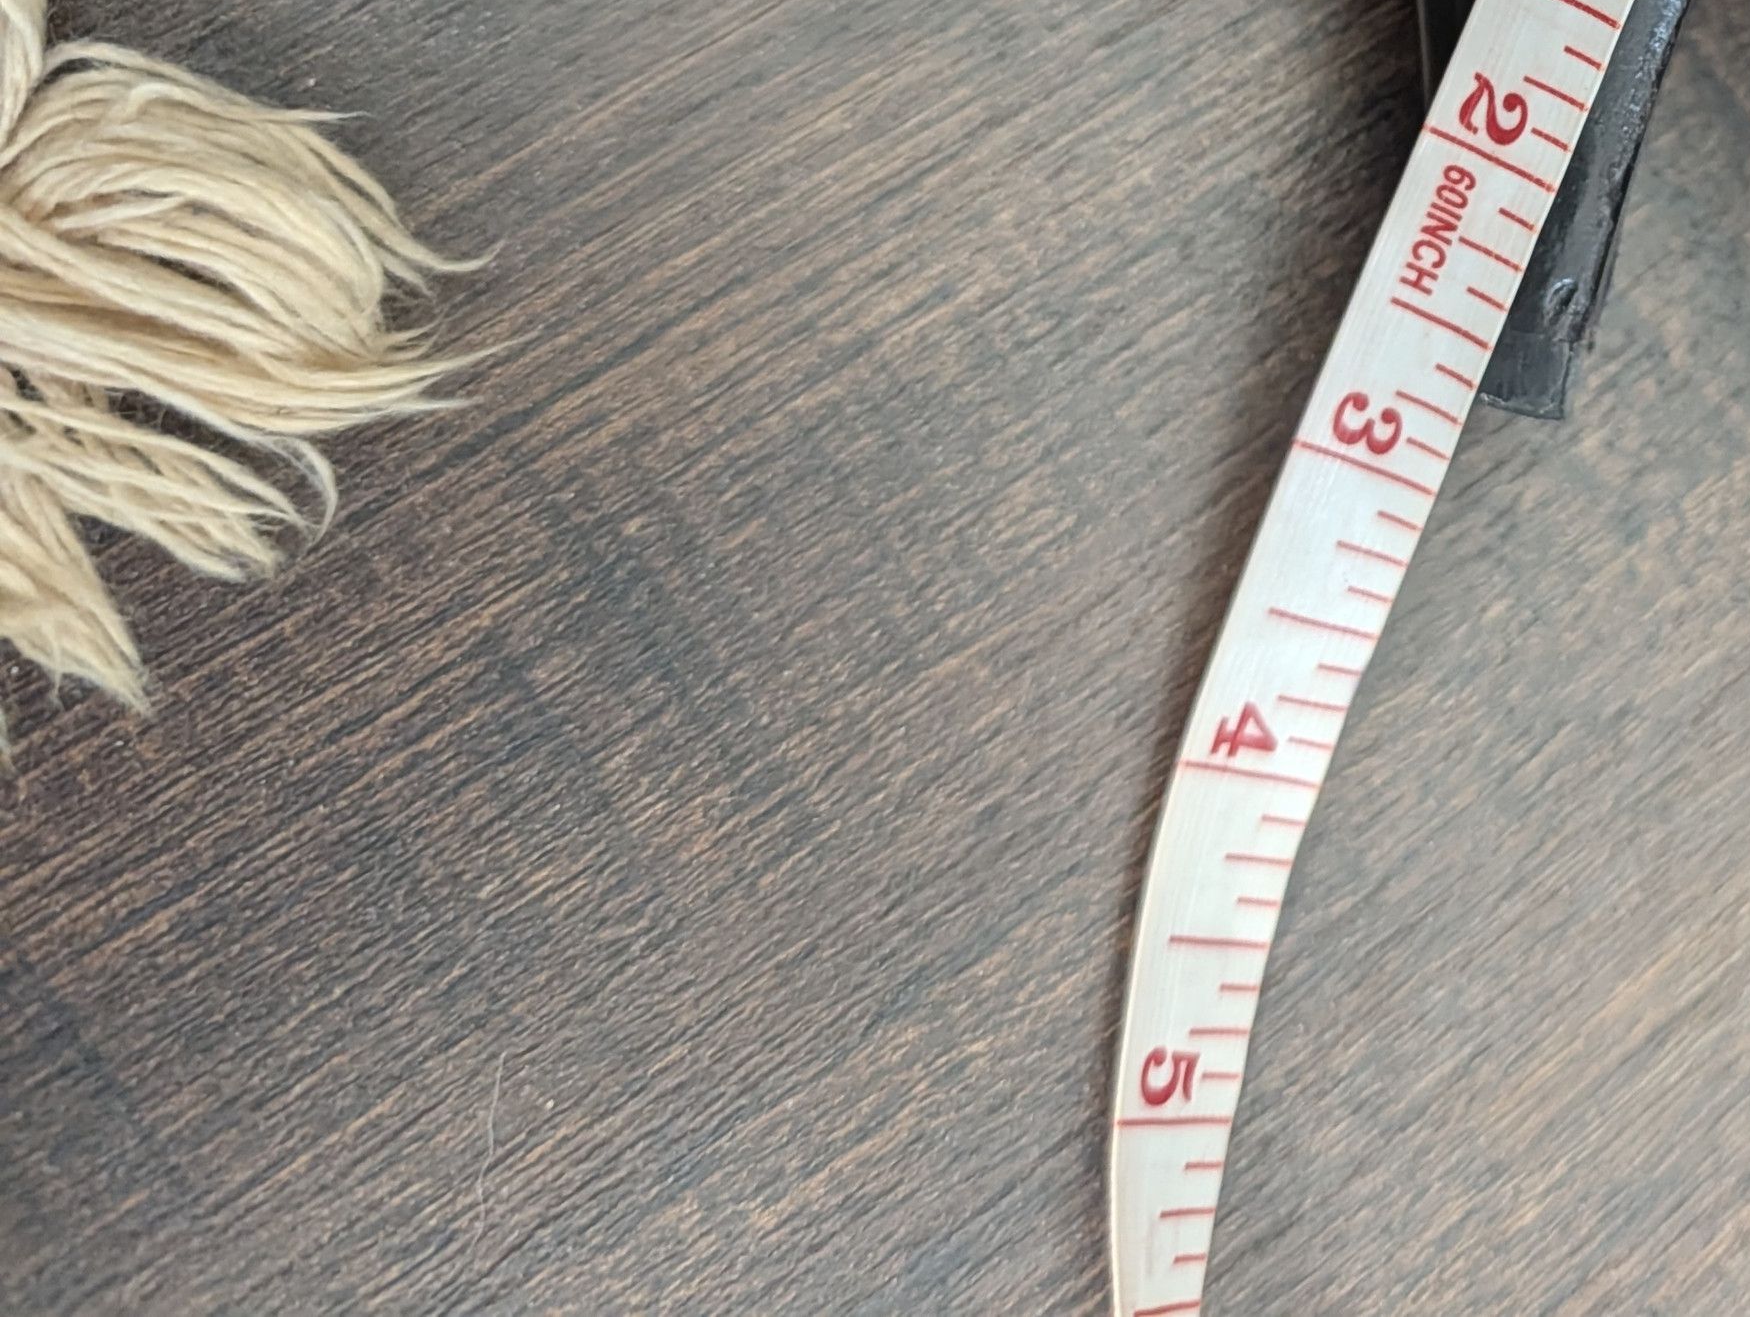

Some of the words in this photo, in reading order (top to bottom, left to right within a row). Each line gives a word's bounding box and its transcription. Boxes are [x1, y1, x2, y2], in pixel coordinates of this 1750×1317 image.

[1458, 72, 1529, 146] 2
[1398, 163, 1477, 296] 60INCH
[1332, 392, 1402, 455] 3
[1210, 702, 1278, 757] 4
[1140, 1046, 1200, 1107] 5
